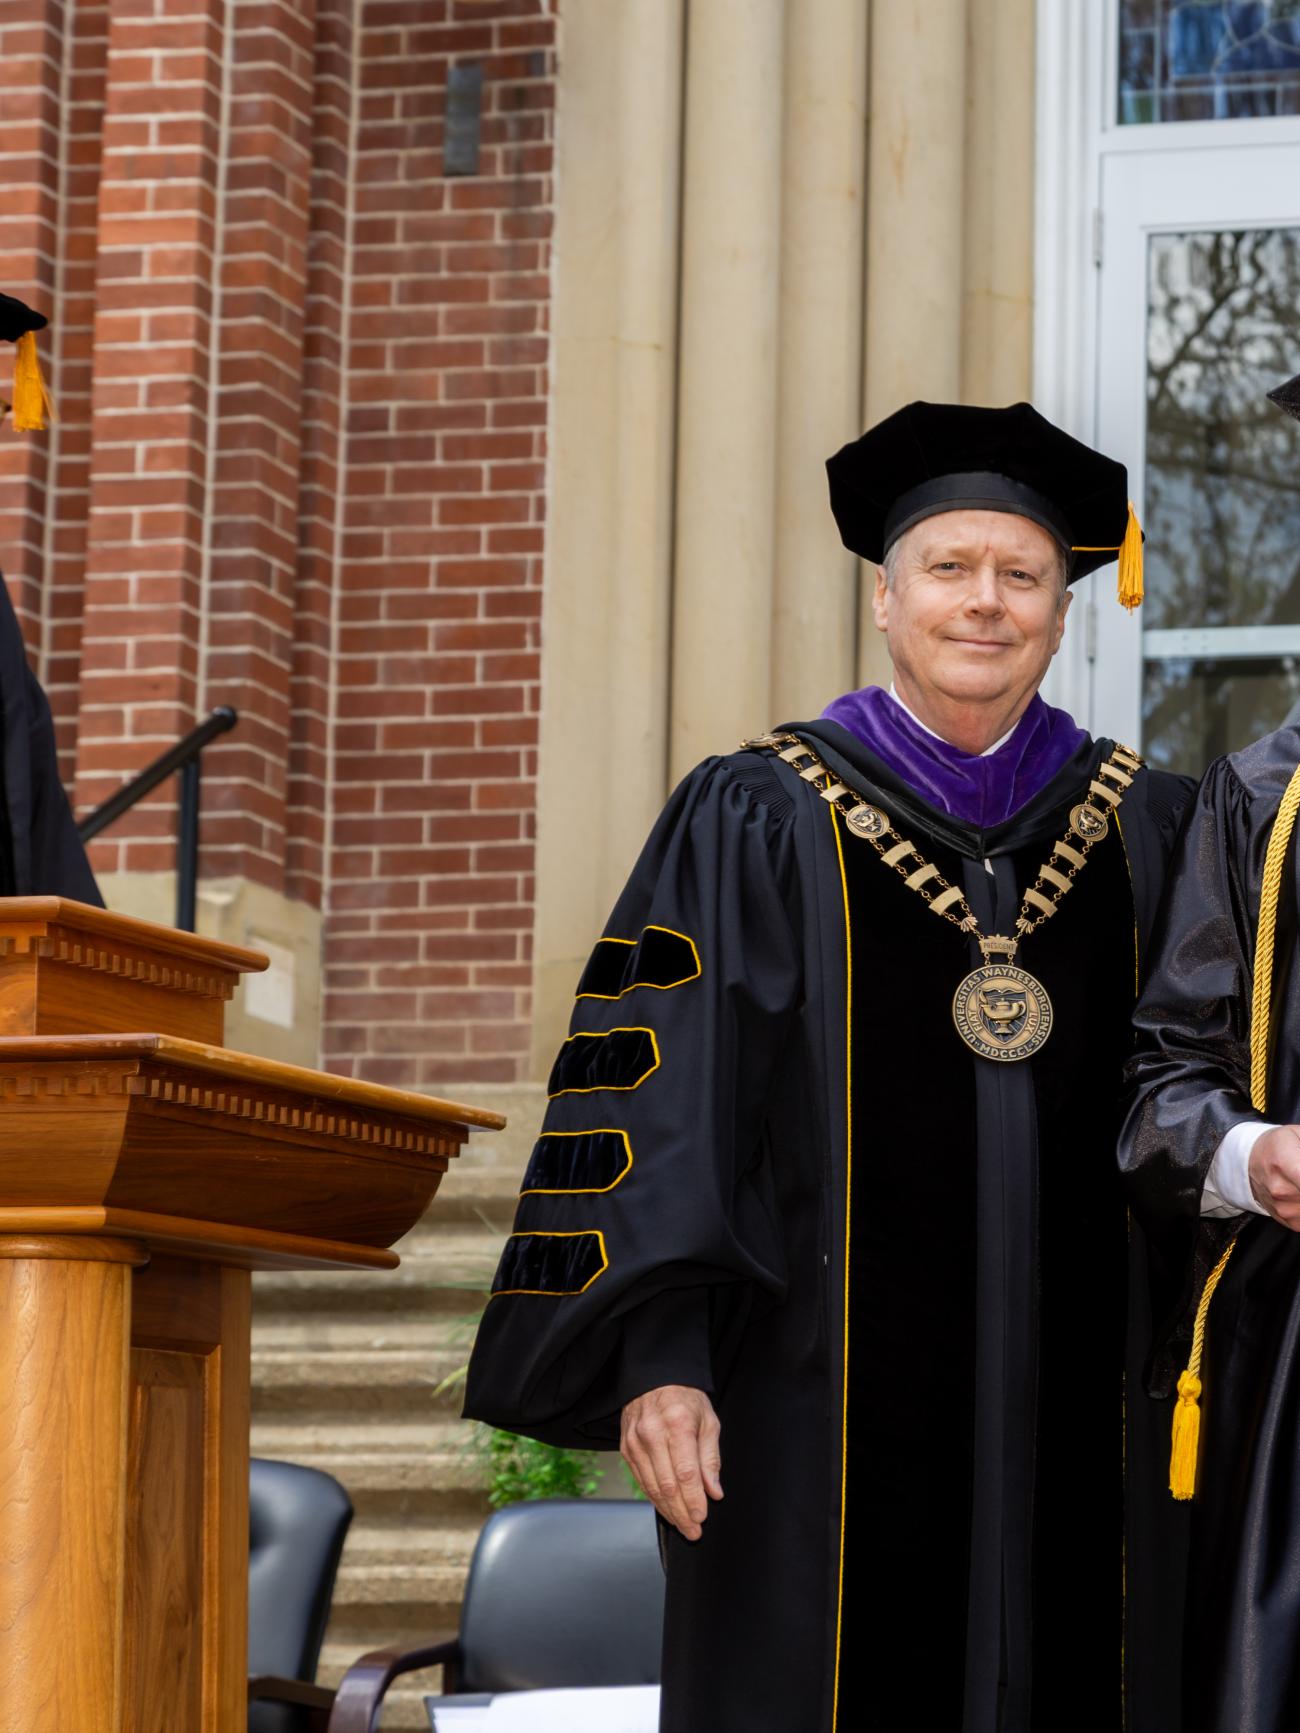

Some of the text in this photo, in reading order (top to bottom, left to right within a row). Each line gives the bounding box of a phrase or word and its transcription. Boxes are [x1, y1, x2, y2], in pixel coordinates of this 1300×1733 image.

[983, 941, 1015, 951] PRESIDENT
[956, 967, 1050, 1046] UNIVERSITAS WAYNESBURGIENSIS
[968, 1010, 983, 1032] FIAT
[1025, 1012, 1038, 1033] LUX
[979, 1043, 1033, 1059] MDCCCL
